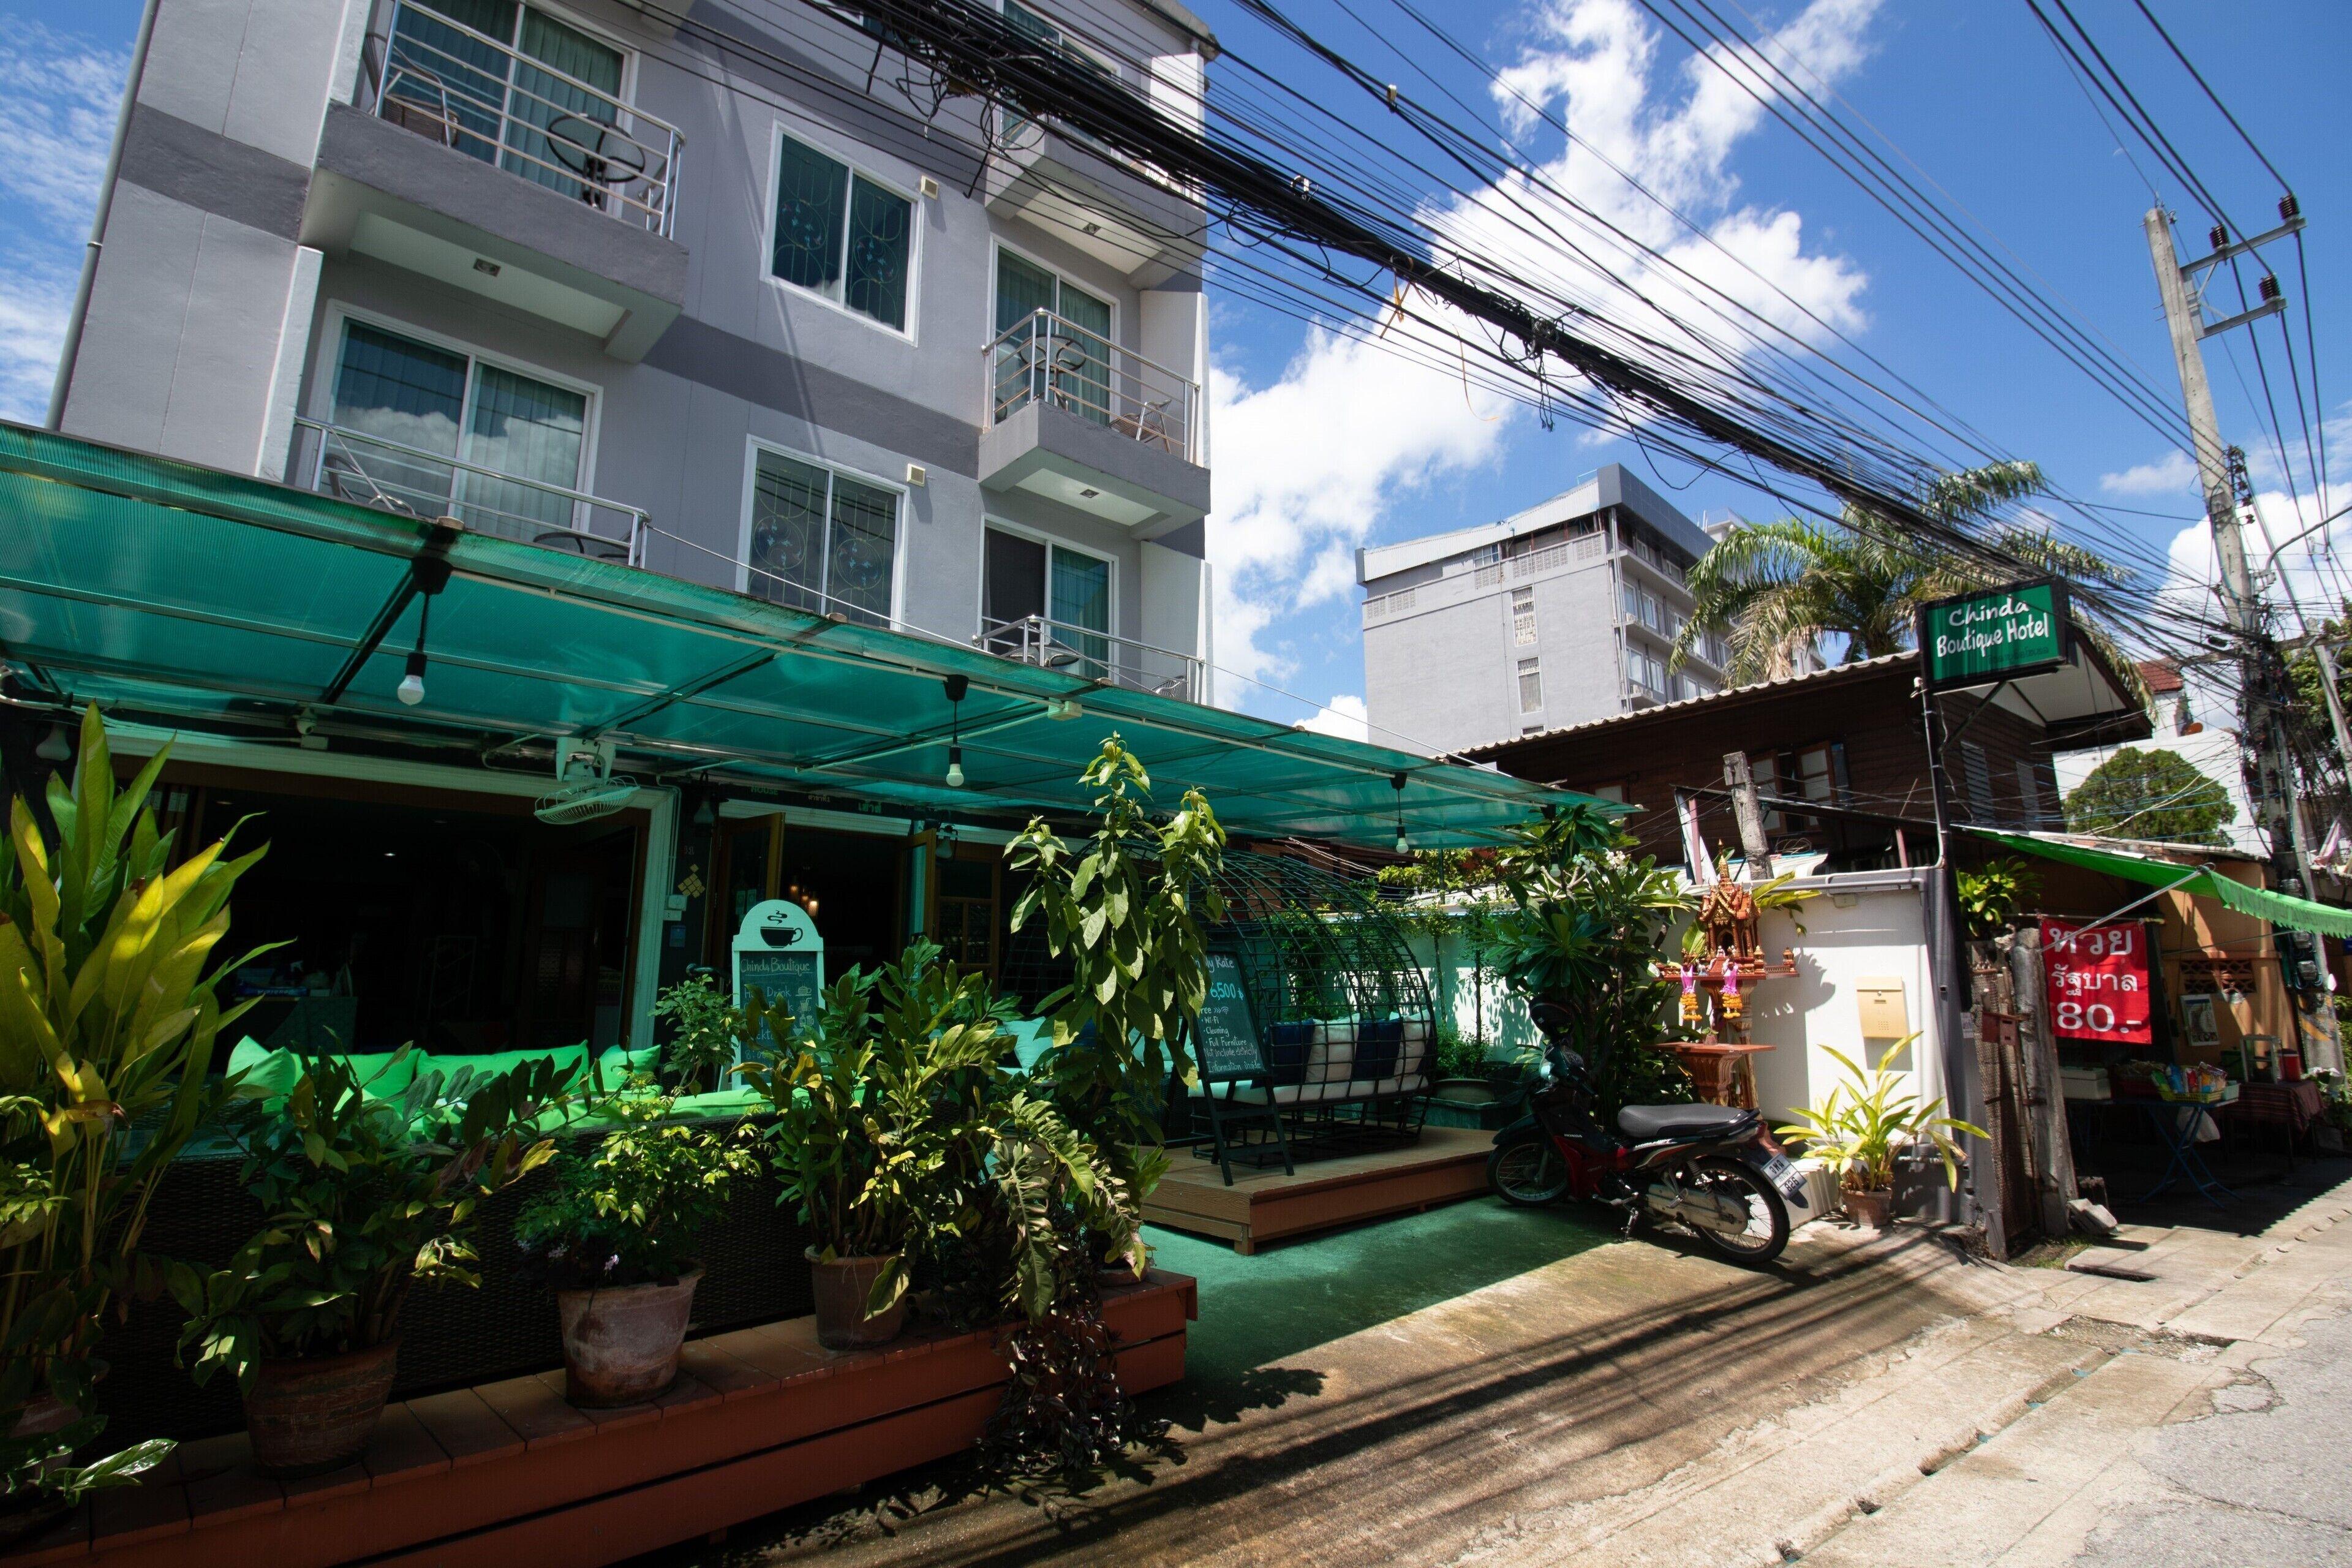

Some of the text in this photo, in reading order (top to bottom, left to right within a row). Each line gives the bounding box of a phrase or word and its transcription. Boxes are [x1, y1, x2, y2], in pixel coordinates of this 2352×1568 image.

[1948, 594, 2030, 627] Chinda
[1936, 628, 2003, 657] Boutique
[2006, 612, 2049, 643] Hotel
[2049, 927, 2133, 956] หวย
[740, 957, 810, 977] Chinda Boutique
[1215, 954, 1235, 968] Rate
[2051, 963, 2138, 997] รัฐบาล
[1208, 1035, 1247, 1047] Full Furniture
[1207, 1060, 1242, 1072] Information
